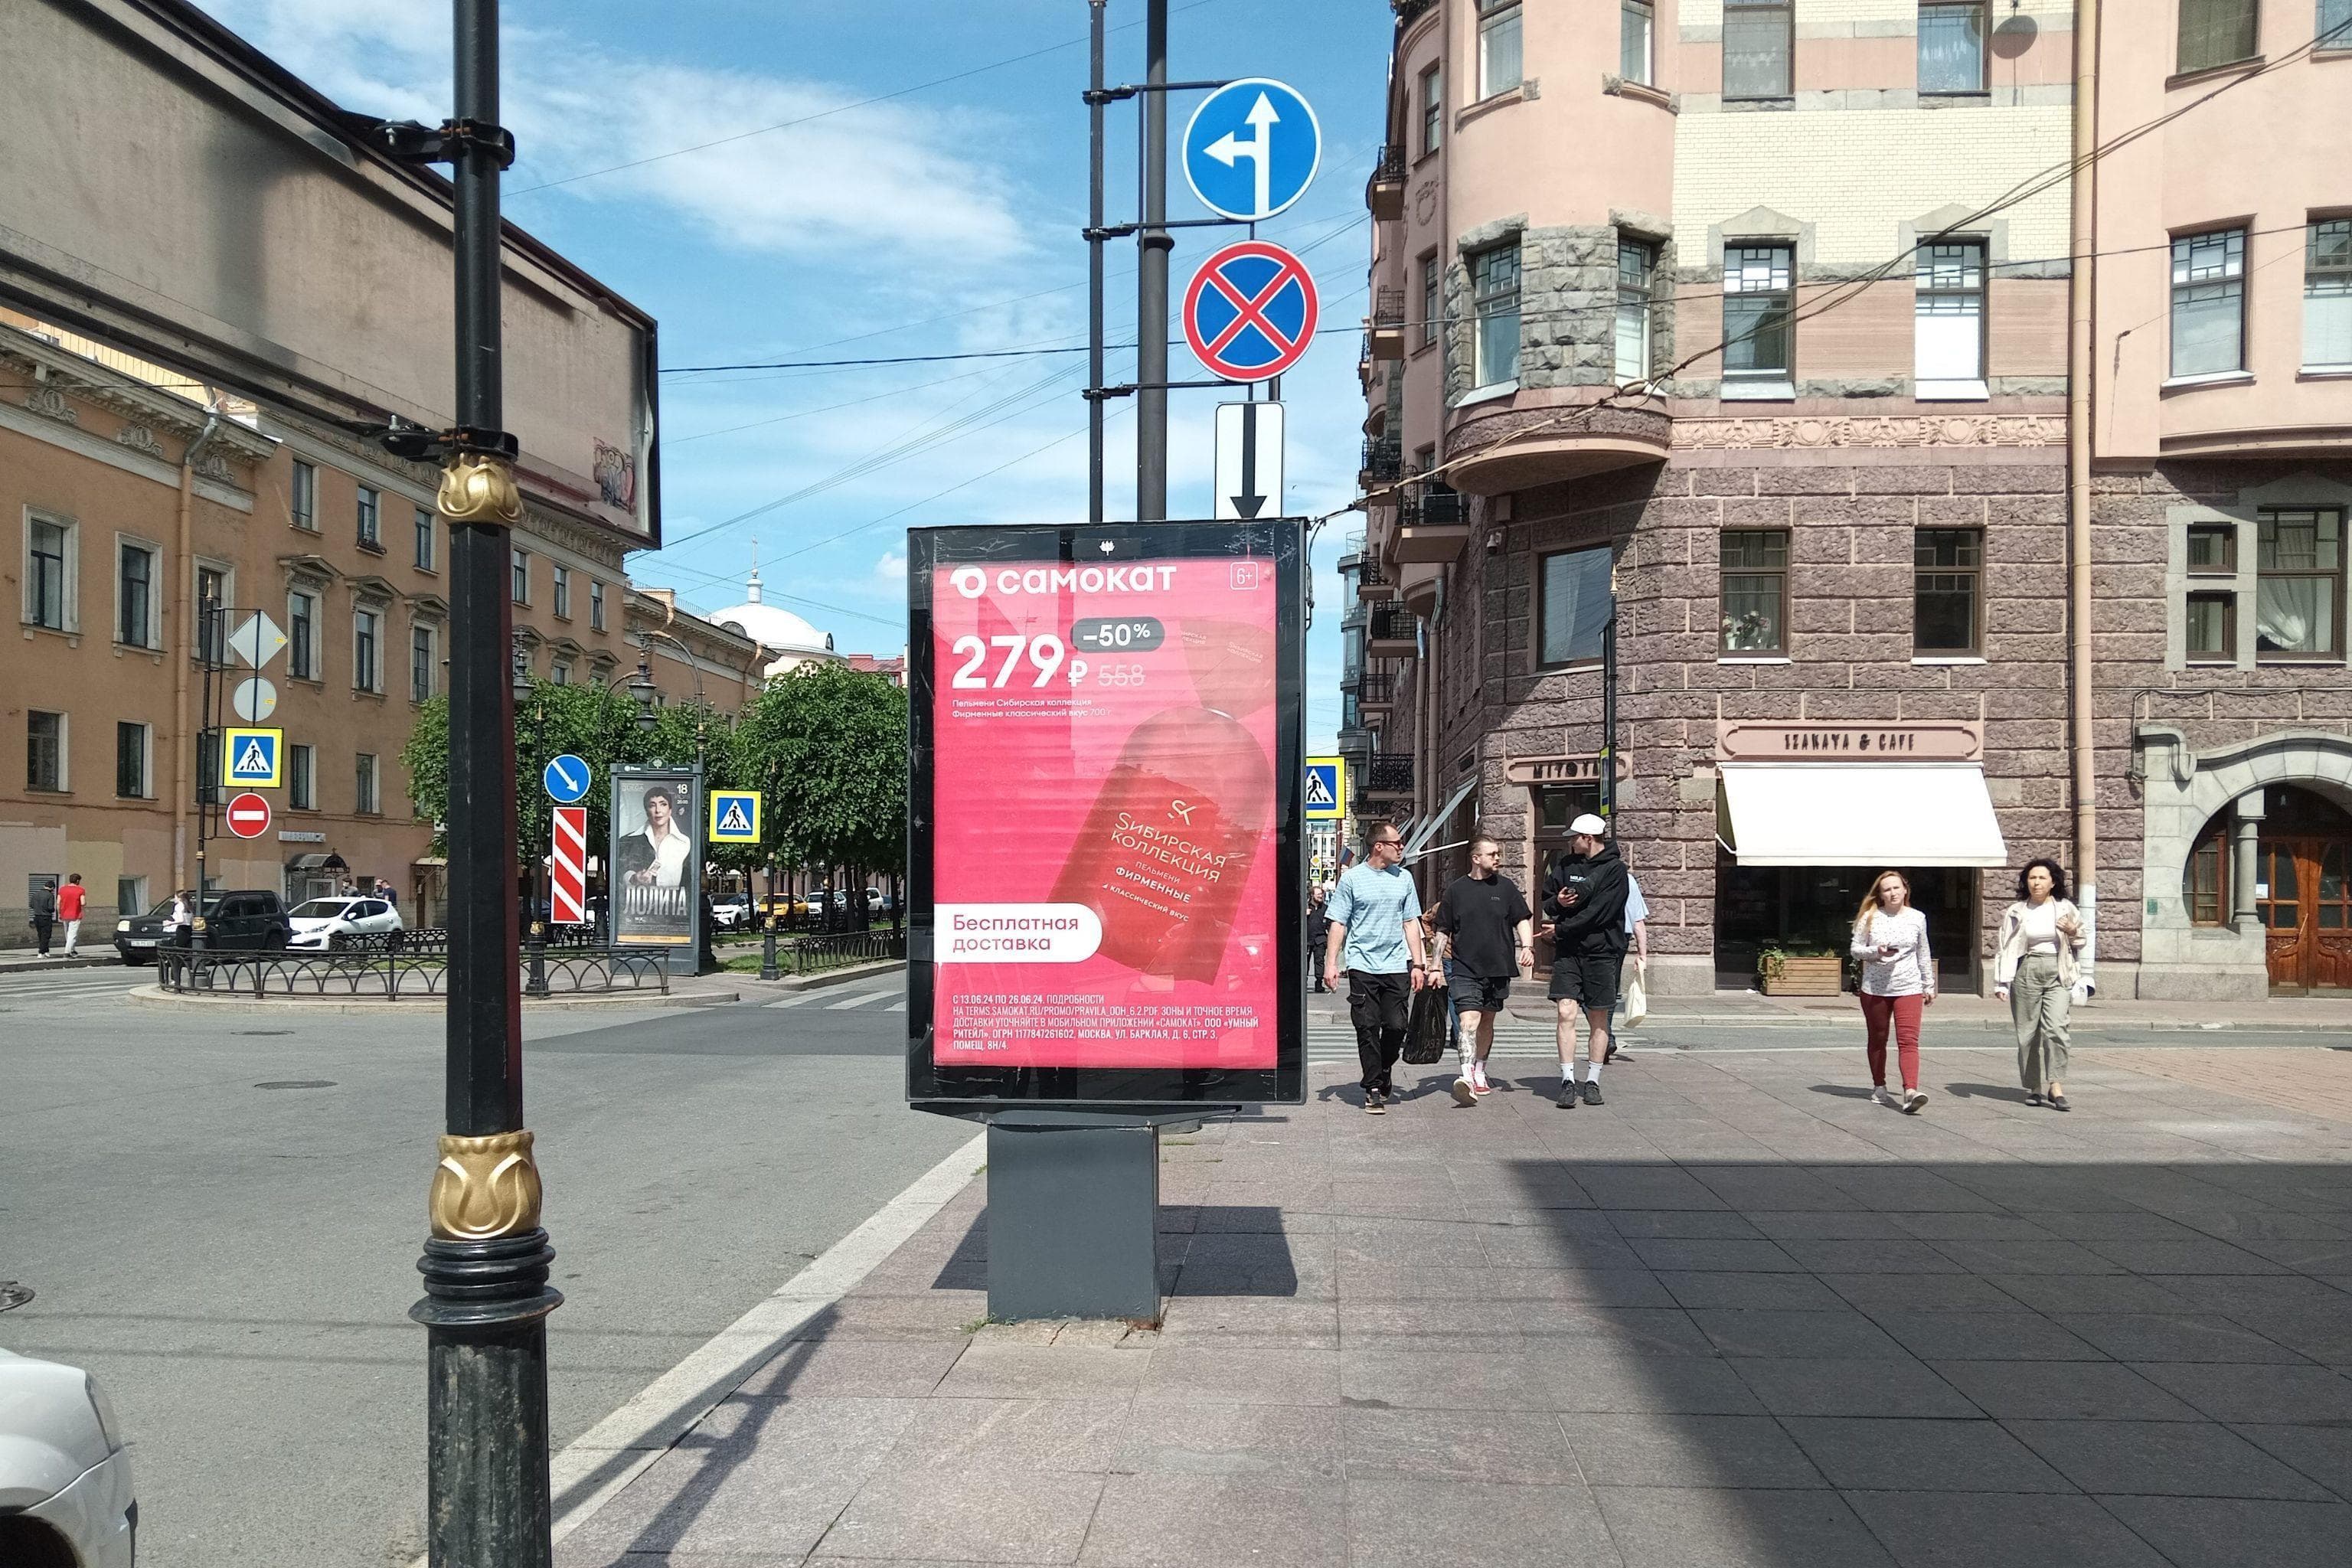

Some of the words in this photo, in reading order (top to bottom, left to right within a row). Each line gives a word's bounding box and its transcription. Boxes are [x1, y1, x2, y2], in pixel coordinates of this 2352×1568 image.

[997, 566, 1177, 595] самокат
[1236, 568, 1253, 584] 6+
[1083, 623, 1150, 647] -50%
[1098, 664, 1145, 687] 558
[996, 698, 1044, 708] Сибирская
[1047, 699, 1092, 707] коллекция
[952, 710, 1003, 719] Фирменные
[1068, 710, 1088, 718] вкус
[1785, 733, 1850, 750] IZAKAYA
[1859, 733, 1870, 751] &
[1879, 733, 1914, 751] CAFE
[677, 783, 688, 794] 18
[1111, 831, 1221, 884] КОЛЛЕКЦИЯ
[1135, 861, 1181, 884] ПЕЛЬМЕНИ
[1116, 867, 1192, 903] ФИРМЕННЫЕ
[623, 885, 687, 916] ЛОЛИТА
[1109, 885, 1168, 913] КЛАССИЧЕСКИЙ
[1169, 910, 1189, 923] ВКУС
[953, 914, 1079, 931] Бесплатная
[953, 939, 1050, 953] доставка
[960, 995, 993, 1004] 13.06.24
[995, 995, 1006, 1004] ПО
[1008, 995, 1044, 1004] 26.06.24.
[1047, 995, 1104, 1005] ПОДРОБНОСТИ
[953, 1006, 964, 1015] НА
[1161, 1006, 1184, 1016] ЗОНЫ
[1186, 1006, 1191, 1016] И
[1194, 1006, 1223, 1016] ТОЧНОЕ
[1226, 1006, 1253, 1016] ВРЕМЯ
[953, 1018, 994, 1027] ДОСТАВКИ
[996, 1017, 1038, 1027] УТОЧНЯЙТЕ
[1040, 1018, 1045, 1027] В
[1047, 1018, 1097, 1027] МОБИЛЬНОМ
[1099, 1018, 1154, 1027] ПРИЛОЖЕНИИ
[1204, 1018, 1222, 1027] ООО
[1223, 1016, 1259, 1029] «УМНЫЙ
[992, 1029, 1012, 1039] ОГРН
[1172, 1030, 1181, 1040] Д.
[1192, 1030, 1208, 1040] СТР.
[953, 1040, 985, 1051] ПОМЕЩ.
